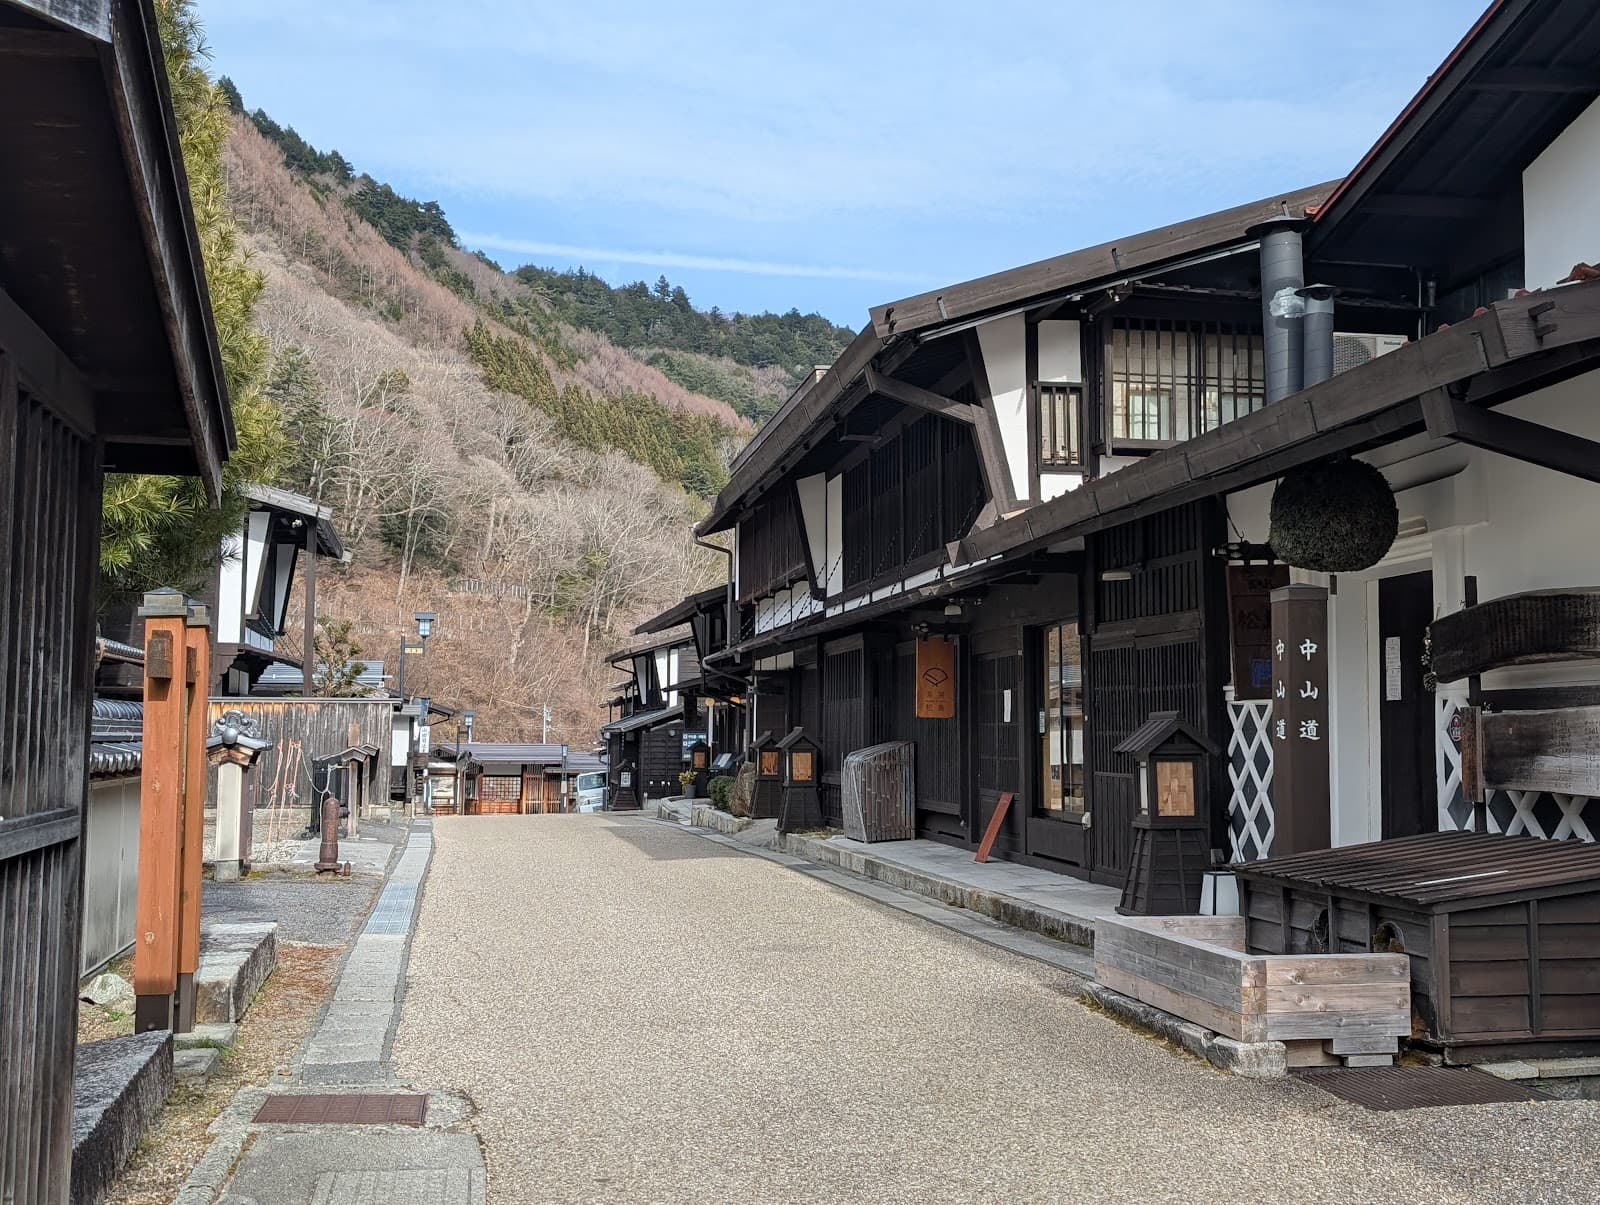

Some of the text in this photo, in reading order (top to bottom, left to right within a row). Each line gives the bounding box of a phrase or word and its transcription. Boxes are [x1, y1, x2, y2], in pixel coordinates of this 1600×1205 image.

[1276, 639, 1286, 740] 中山道
[1299, 639, 1320, 740] 中山道
